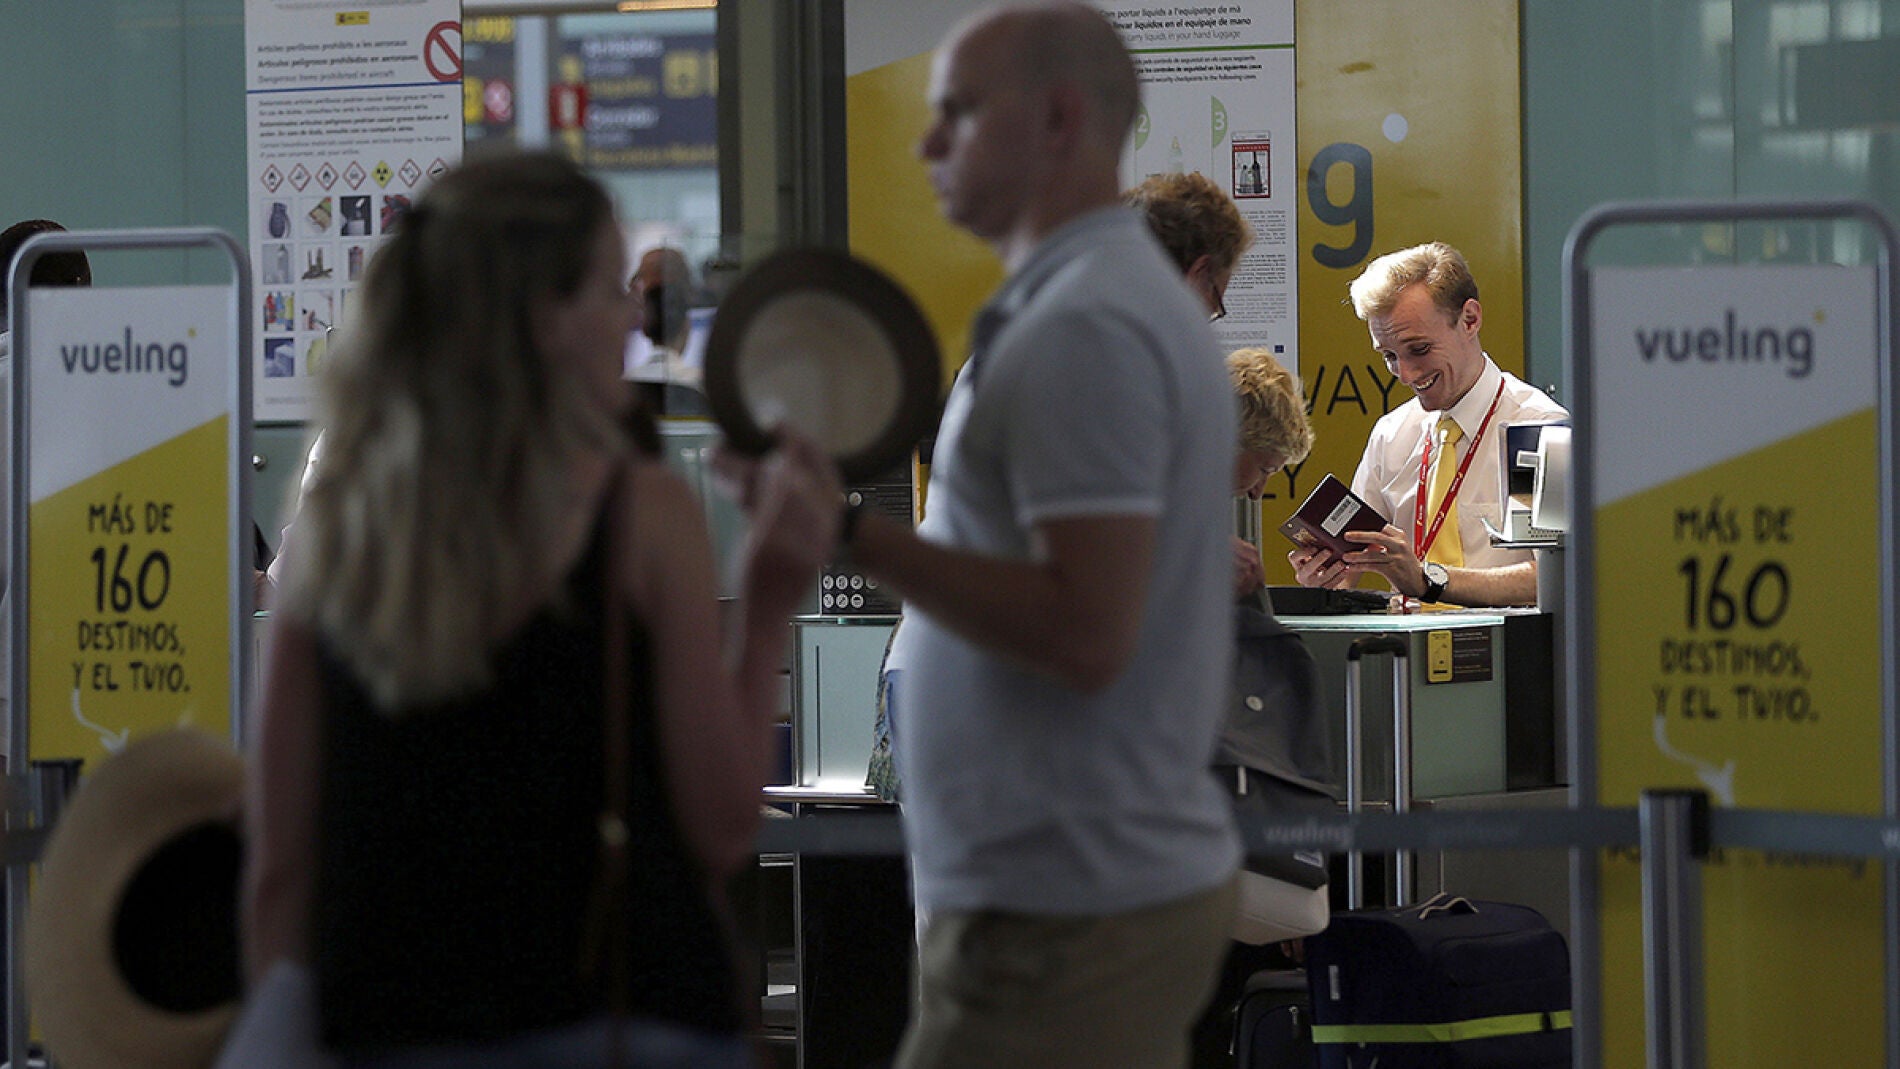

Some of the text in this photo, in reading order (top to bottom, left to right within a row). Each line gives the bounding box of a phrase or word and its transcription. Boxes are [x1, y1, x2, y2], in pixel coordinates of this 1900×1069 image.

[1229, 18, 1252, 26] mano
[1137, 114, 1147, 133] 2
[1215, 112, 1225, 131] 3
[61, 324, 188, 388] vueling
[1635, 309, 1815, 379] vueling
[88, 493, 173, 535] MÁS DE
[1674, 496, 1795, 543] MÁS DE
[90, 542, 171, 614] 160
[1678, 552, 1791, 633] 160
[78, 620, 185, 656] DESTINOS,
[73, 660, 84, 690] Y
[93, 663, 119, 691] EL
[1652, 685, 1671, 717] Y
[1681, 686, 1719, 720] EL
